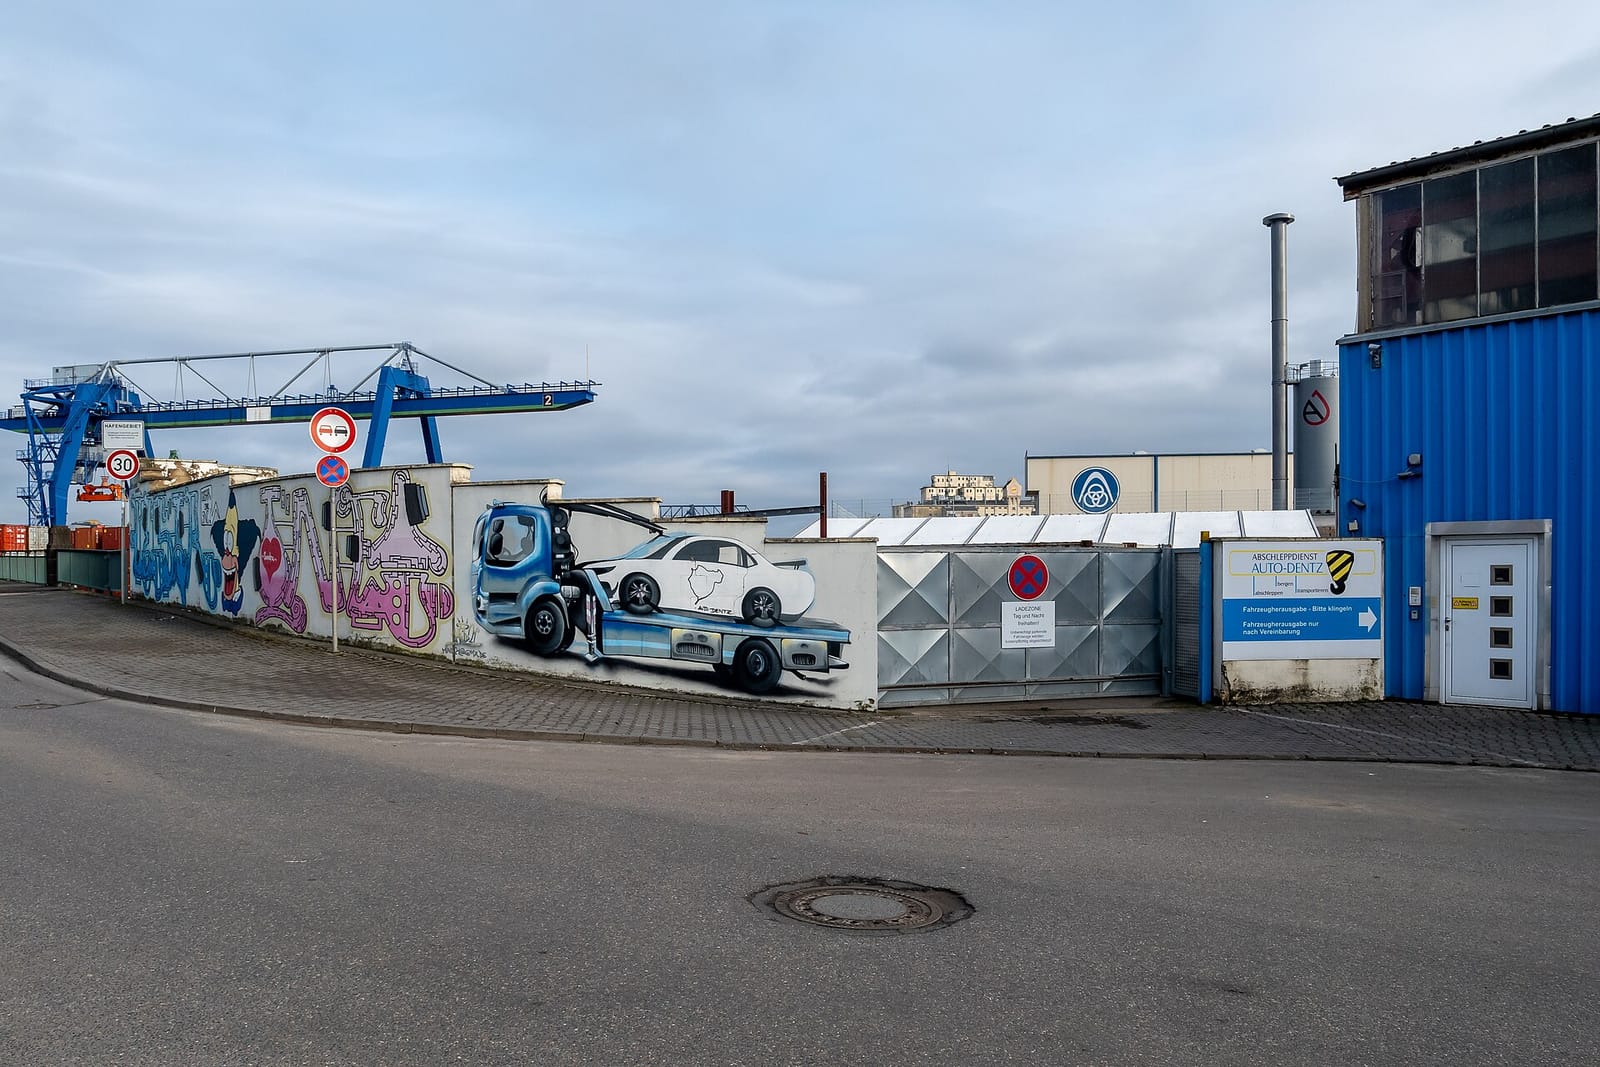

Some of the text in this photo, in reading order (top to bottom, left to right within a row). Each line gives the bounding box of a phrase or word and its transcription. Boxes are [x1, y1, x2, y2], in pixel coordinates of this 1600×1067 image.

[544, 395, 552, 405] 2
[113, 457, 133, 472] 30
[1251, 553, 1317, 561] ABSCHLEPPDIENST
[1251, 562, 1324, 574] AUTO-DENTZ
[1242, 606, 1307, 614] Fahrzeugherausgabe
[1328, 605, 1353, 613] klingeln
[1242, 621, 1307, 629] Fahrzeugherausgabe
[1259, 628, 1301, 636] Vereinbarung
